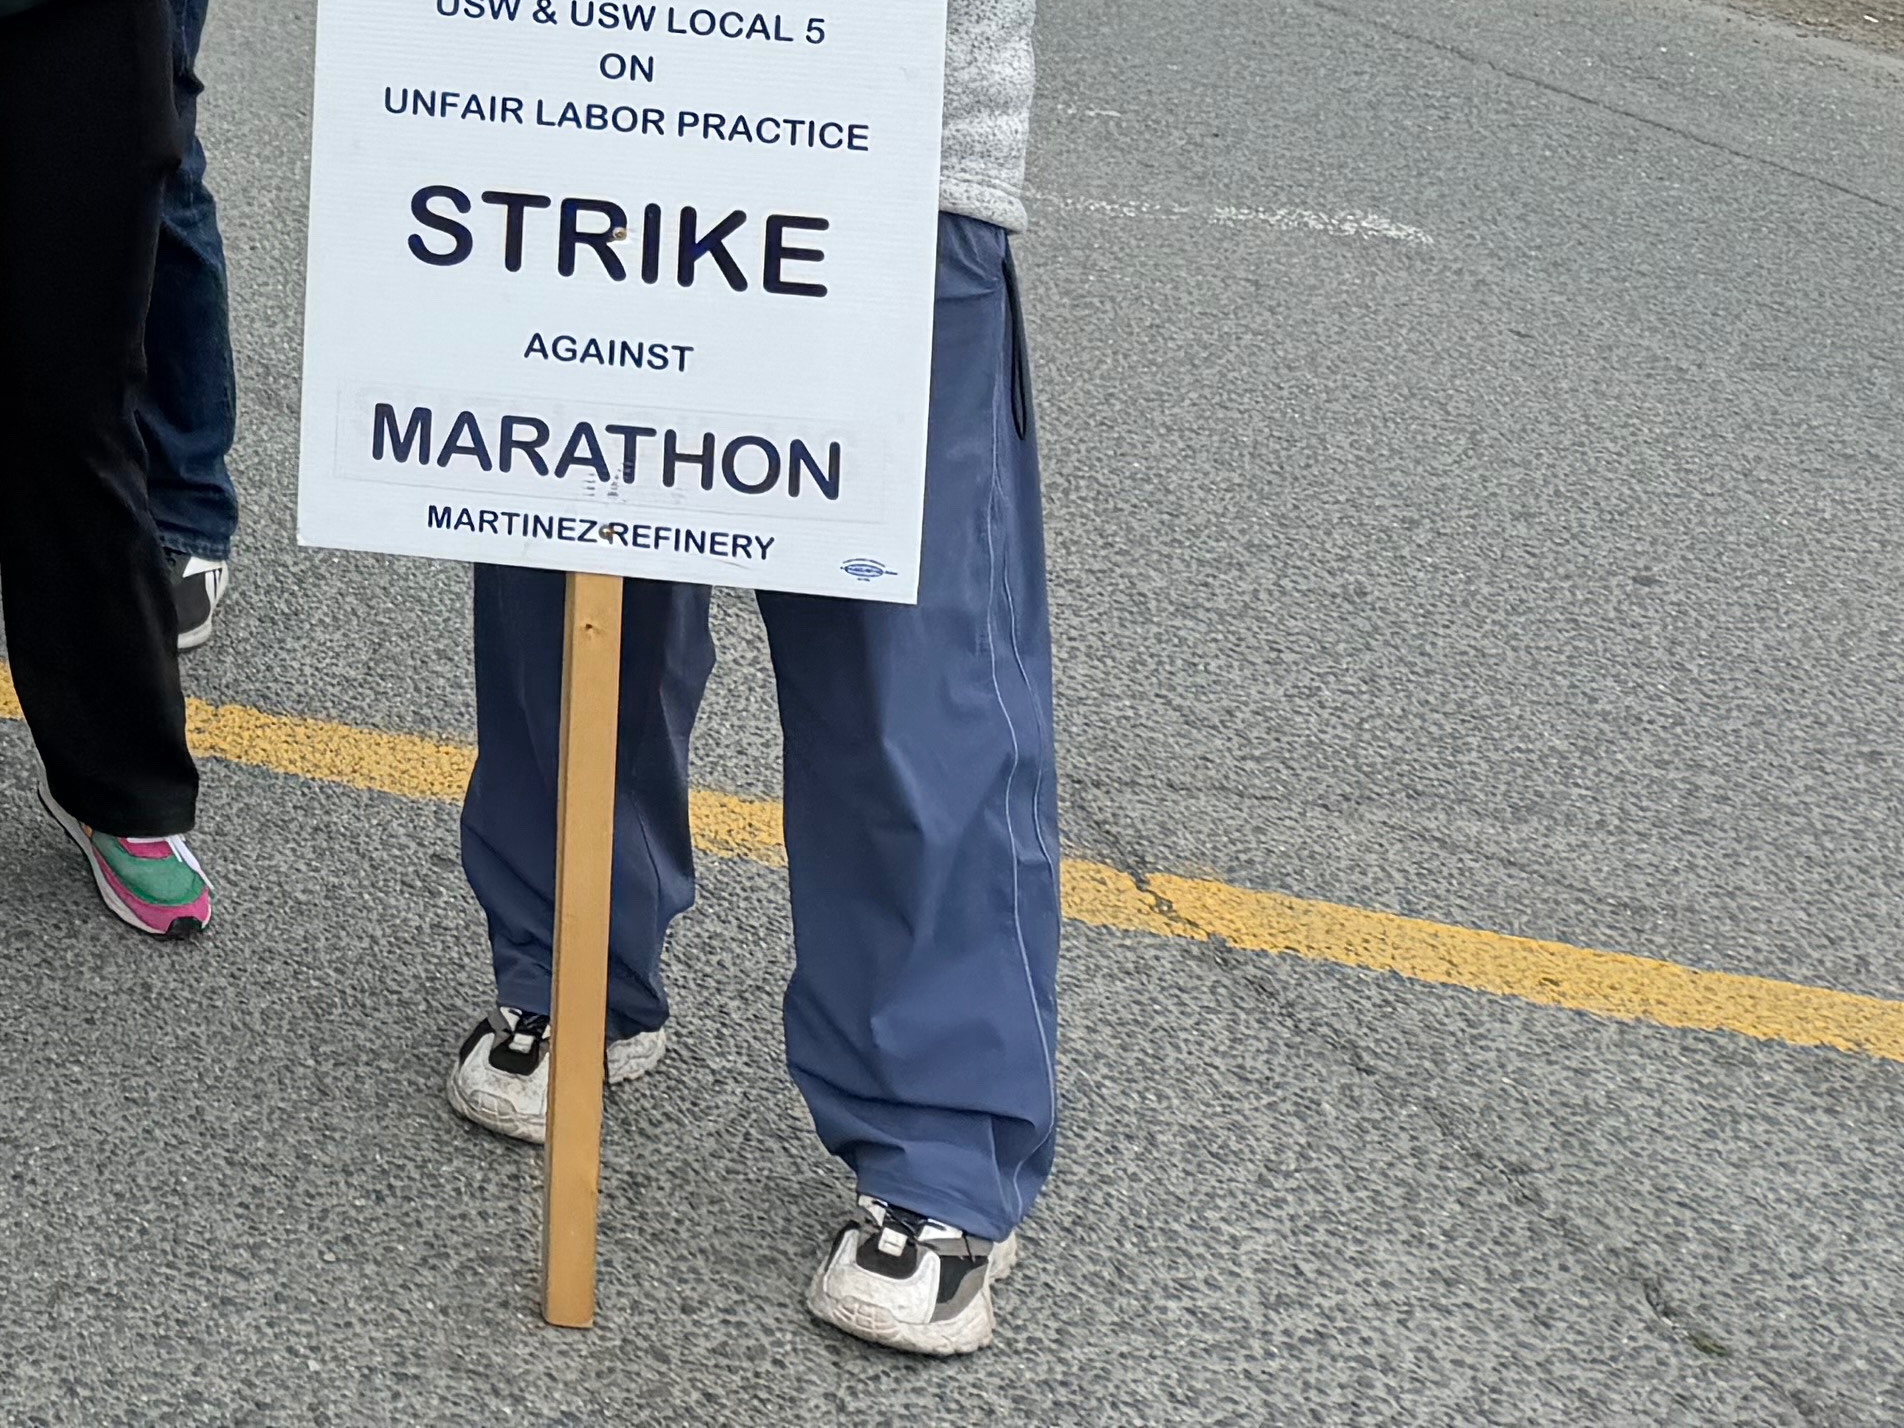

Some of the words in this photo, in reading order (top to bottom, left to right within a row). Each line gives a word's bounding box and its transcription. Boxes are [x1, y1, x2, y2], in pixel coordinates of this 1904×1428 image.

[571, 0, 656, 31] USW
[668, 7, 794, 41] LOCAL
[806, 18, 825, 44] 5
[600, 53, 653, 82] ON
[385, 87, 523, 124] UNFAIR
[537, 99, 664, 135] LABOR
[678, 111, 869, 151] PRACTICE
[408, 185, 829, 297] STRIKE
[524, 333, 694, 372] AGAINST
[372, 403, 840, 500] MARATHON
[427, 506, 597, 542] MARTINEZ
[603, 522, 774, 560] REFINERY
